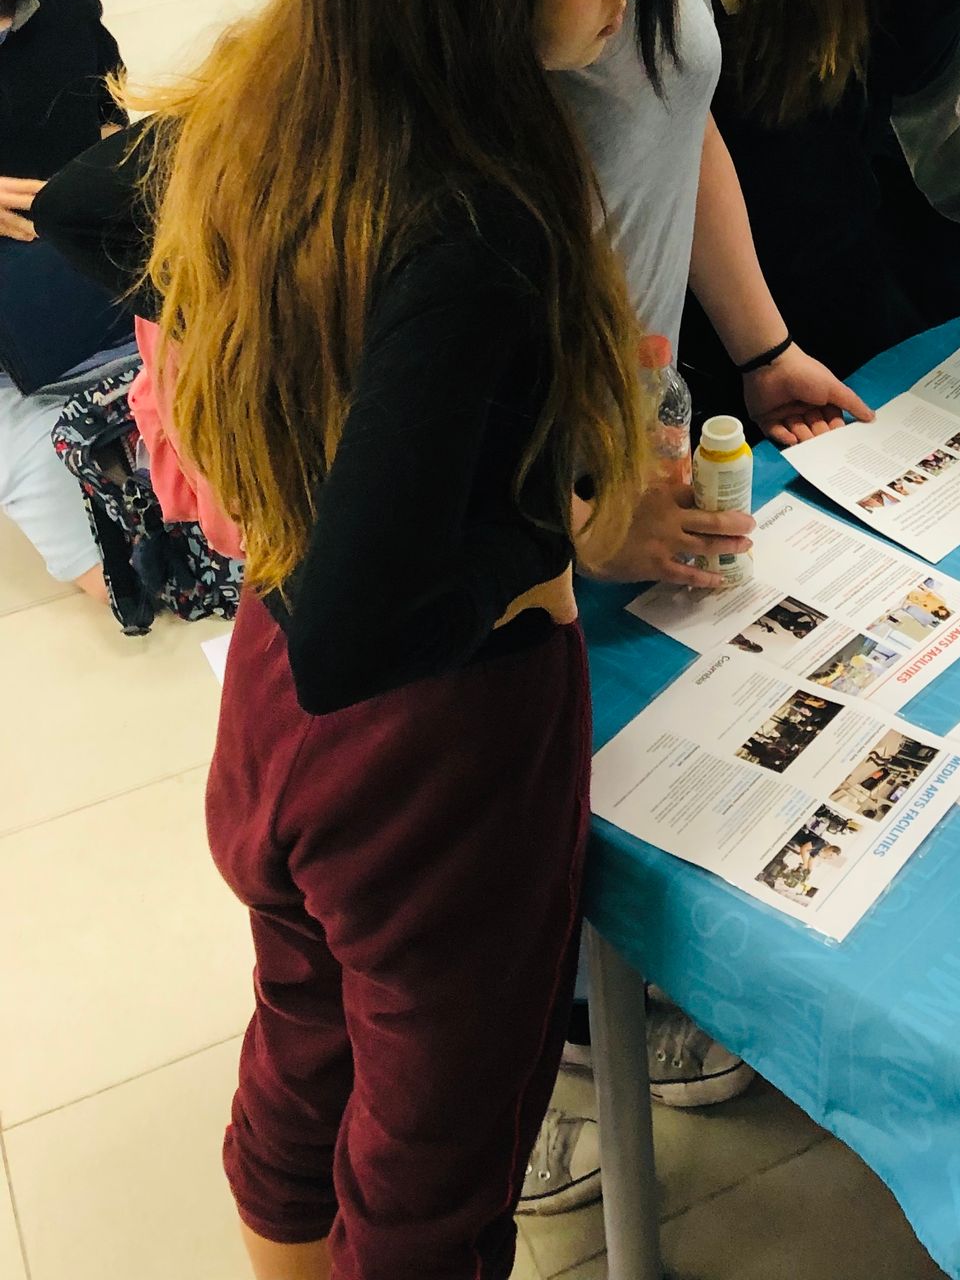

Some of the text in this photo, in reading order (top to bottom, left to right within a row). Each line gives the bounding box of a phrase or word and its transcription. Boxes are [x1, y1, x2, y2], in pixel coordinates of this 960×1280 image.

[759, 504, 793, 530] Columbia
[695, 655, 730, 686] Columbia
[896, 644, 943, 685] FACILITIES
[919, 778, 942, 808] ARTS
[871, 802, 921, 858] FACILITIES
